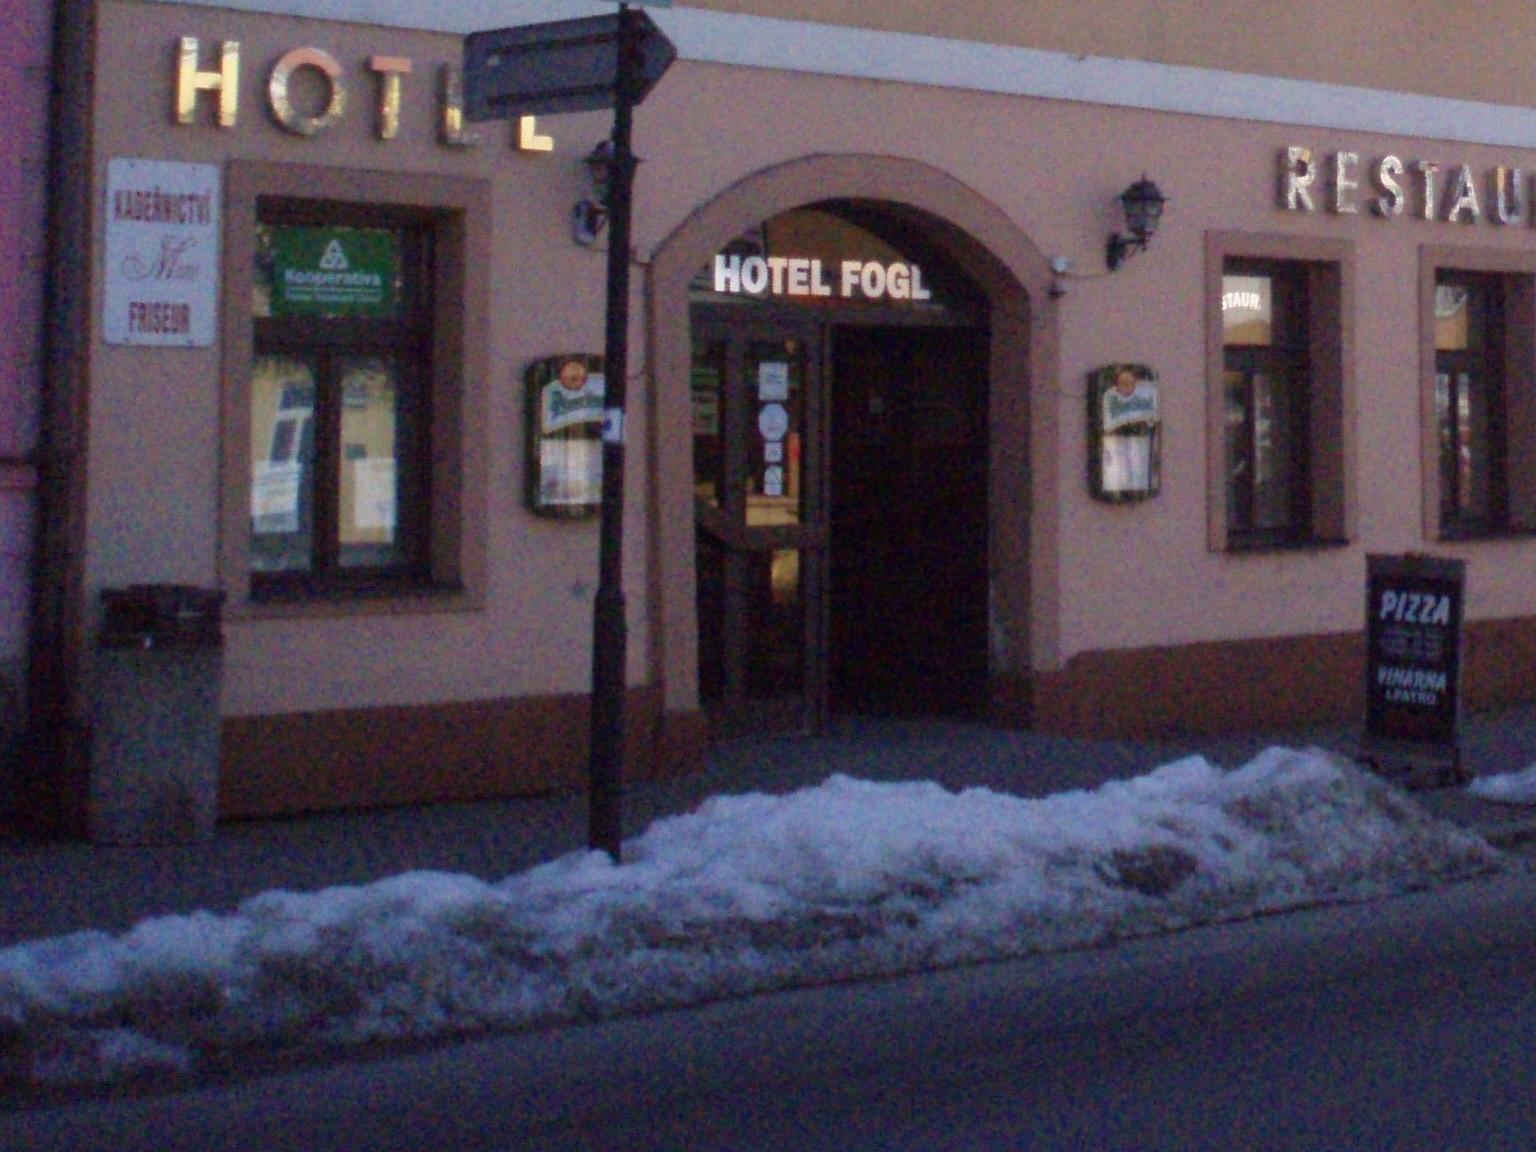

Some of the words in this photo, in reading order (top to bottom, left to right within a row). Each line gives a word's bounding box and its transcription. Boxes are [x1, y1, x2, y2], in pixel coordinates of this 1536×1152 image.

[714, 254, 831, 297] HOTEL
[841, 260, 931, 301] FOGL
[129, 301, 190, 334] FRISEUR
[1380, 589, 1450, 625] PIZZA
